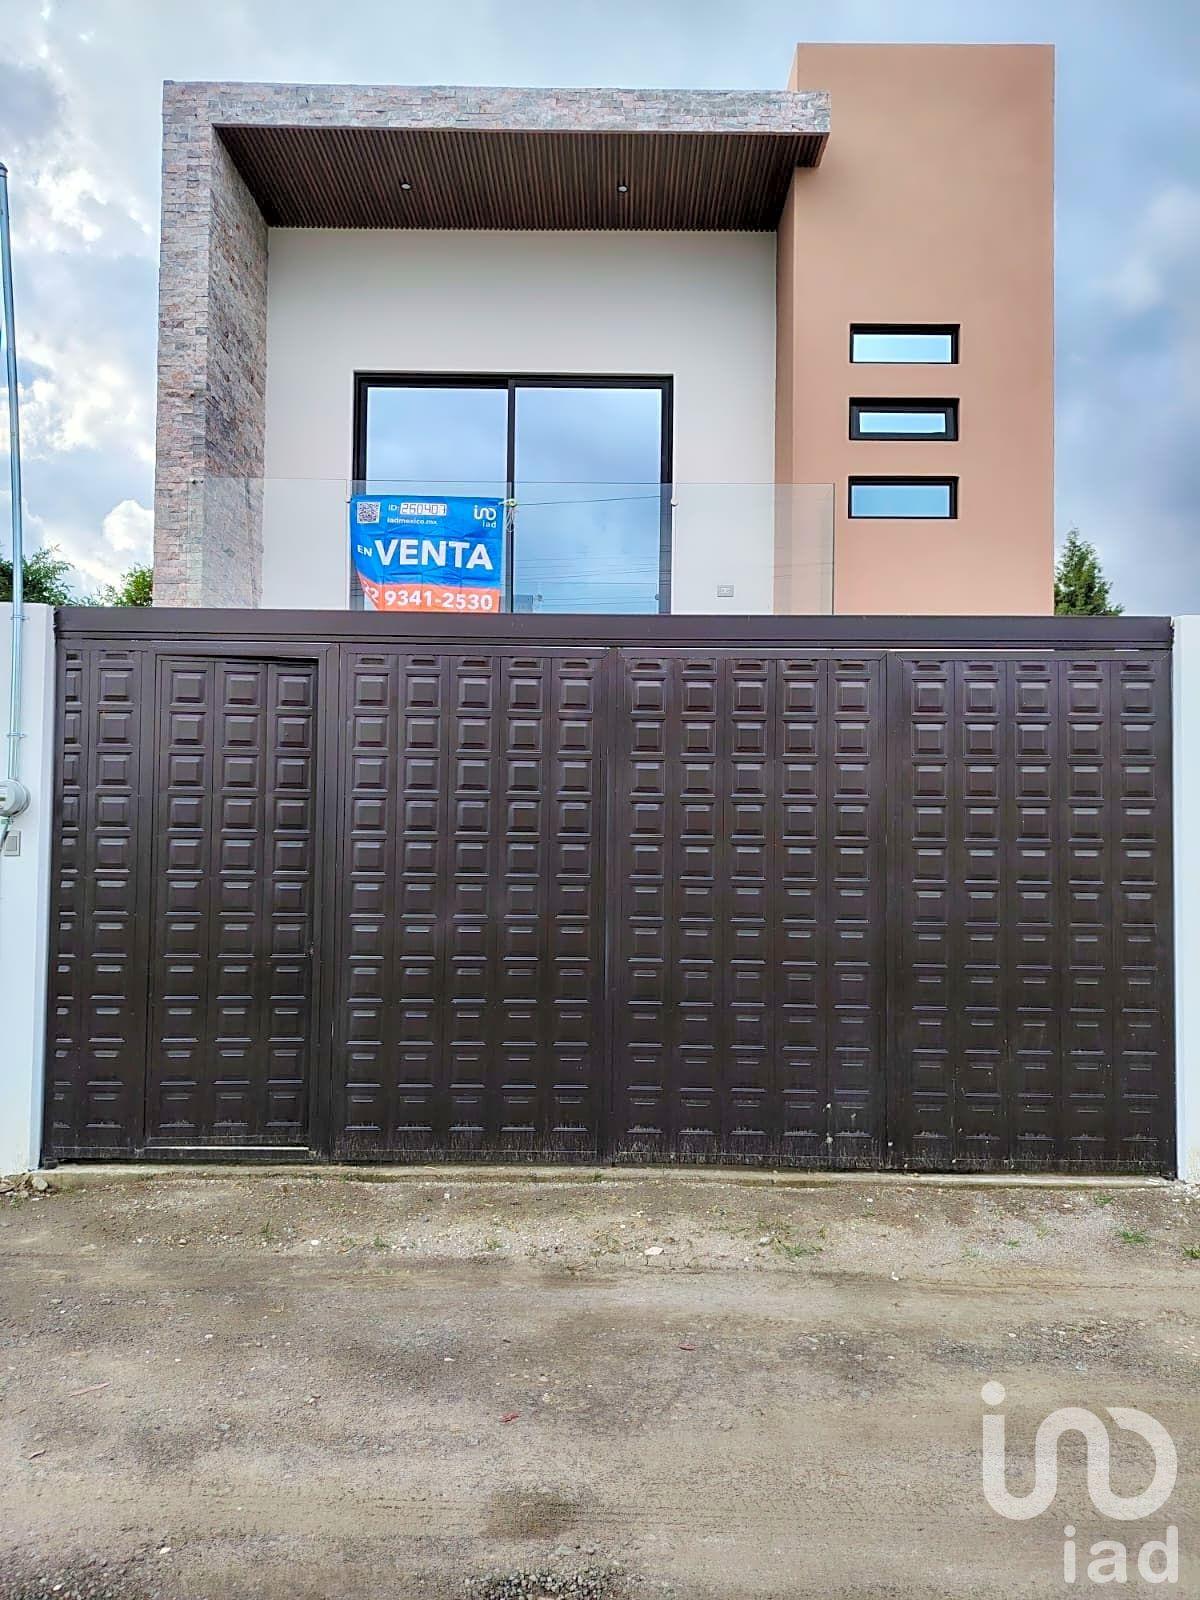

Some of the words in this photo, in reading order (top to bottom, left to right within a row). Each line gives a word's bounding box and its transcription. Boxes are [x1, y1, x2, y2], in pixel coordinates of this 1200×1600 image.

[482, 520, 497, 529] iad
[357, 544, 373, 557] EN
[375, 539, 494, 570] VENTA
[384, 589, 493, 610] 9341-2530
